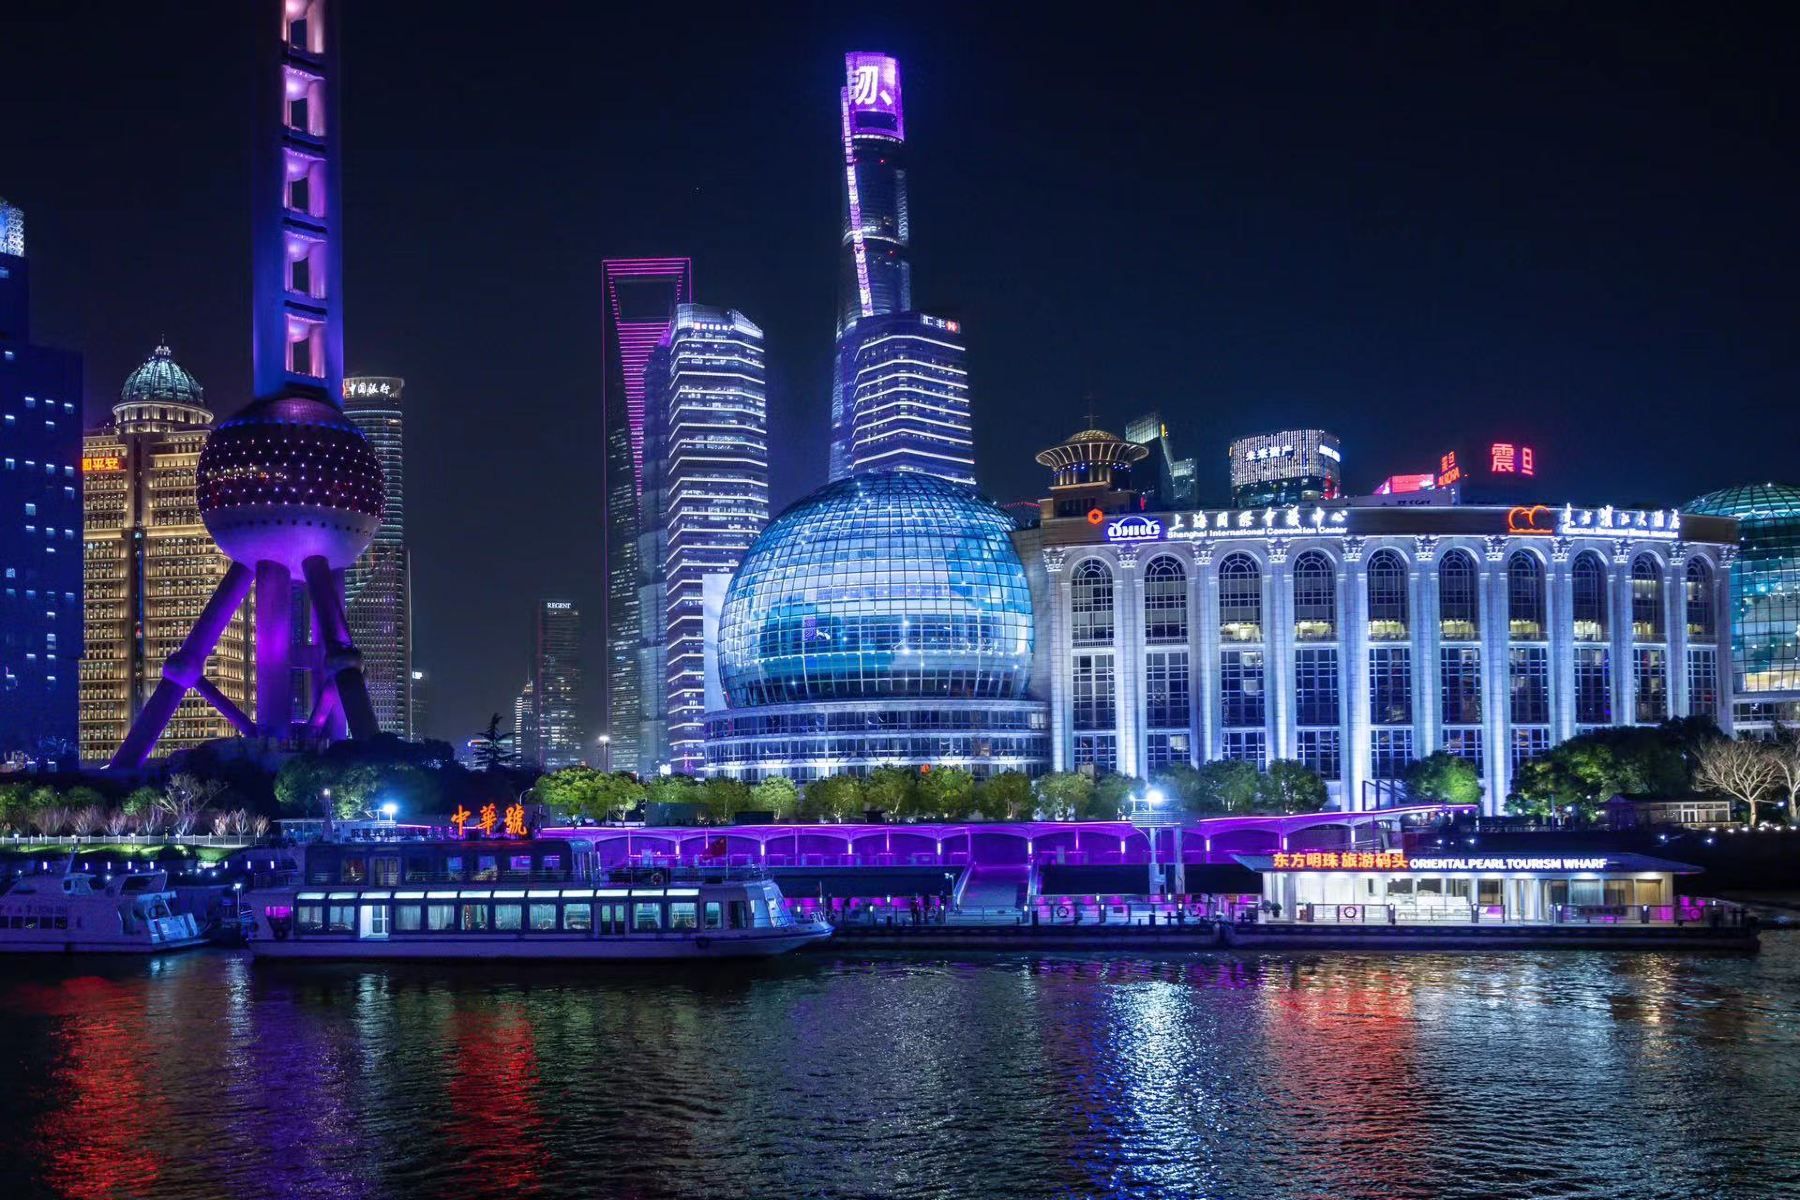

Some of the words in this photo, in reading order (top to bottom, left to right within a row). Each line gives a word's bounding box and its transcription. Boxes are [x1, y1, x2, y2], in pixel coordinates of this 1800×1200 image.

[348, 382, 391, 396] 中国银行
[1491, 442, 1534, 476] 震旦
[1167, 529, 1207, 539] Shanghai
[1209, 527, 1266, 538] International
[1266, 525, 1317, 536] Convention
[1317, 524, 1348, 534] Center
[1409, 858, 1468, 869] ORIENTAL
[1468, 858, 1506, 869] PEARL
[1506, 858, 1562, 869] TOURISM
[1562, 858, 1608, 869] WHARF
